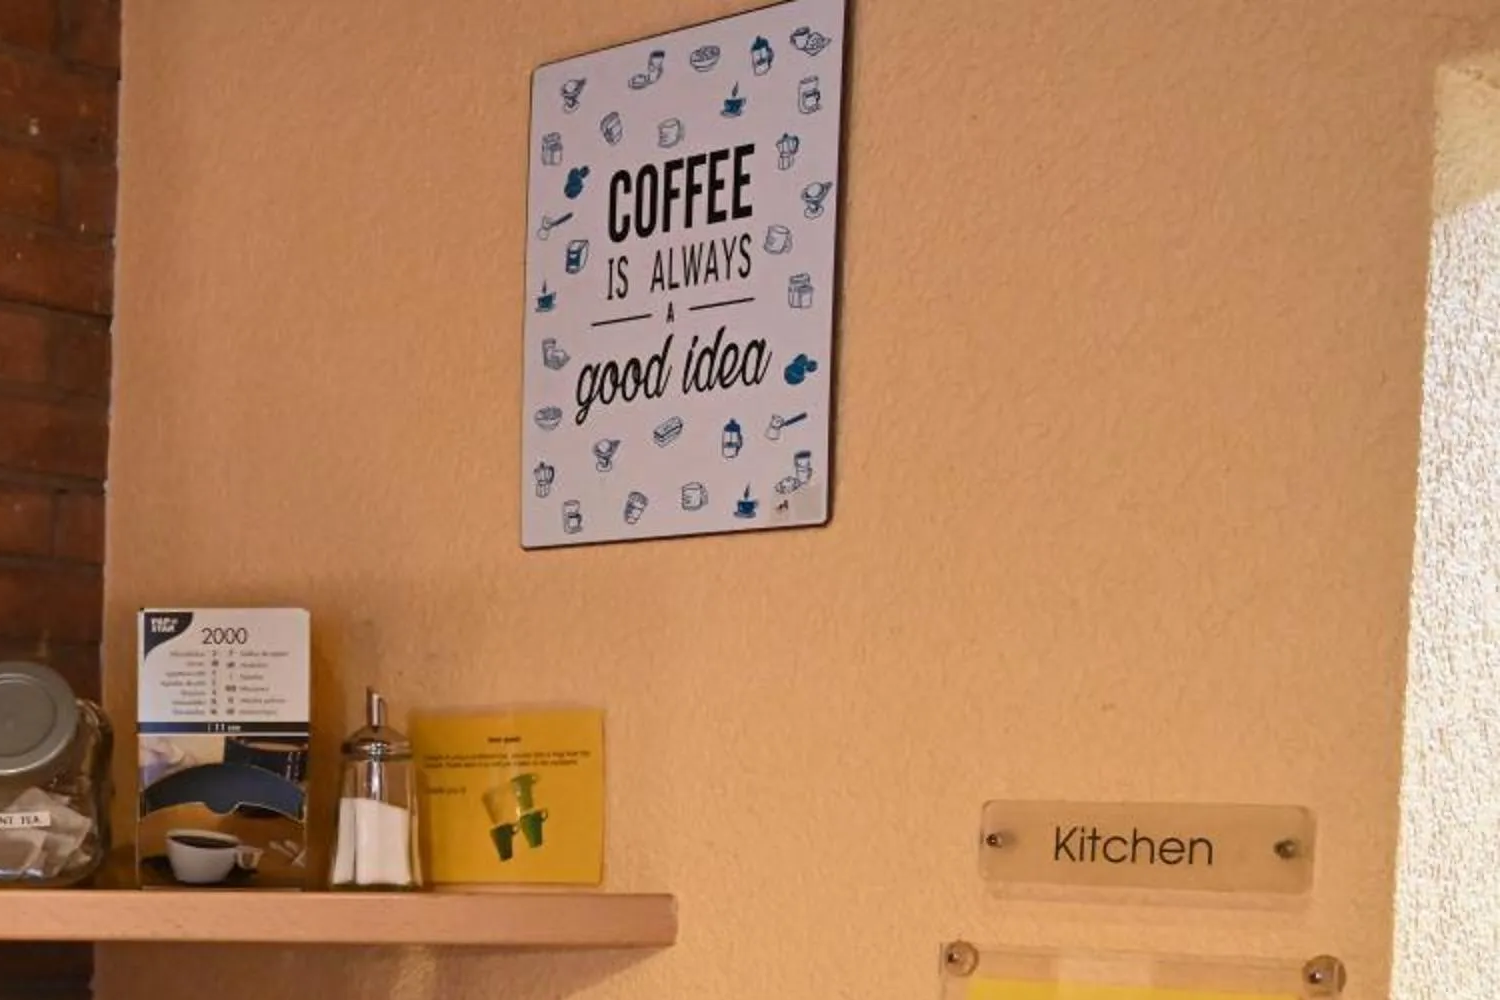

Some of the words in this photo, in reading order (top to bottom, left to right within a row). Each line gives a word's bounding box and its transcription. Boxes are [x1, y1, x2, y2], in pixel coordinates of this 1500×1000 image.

[608, 143, 755, 243] COFFEE
[607, 255, 629, 300] IS
[650, 232, 752, 293] ALWAYS
[666, 301, 675, 323] A
[575, 333, 674, 425] good
[682, 325, 773, 395] idea
[201, 628, 248, 645] 2000
[1054, 826, 1214, 865] Kitchen
